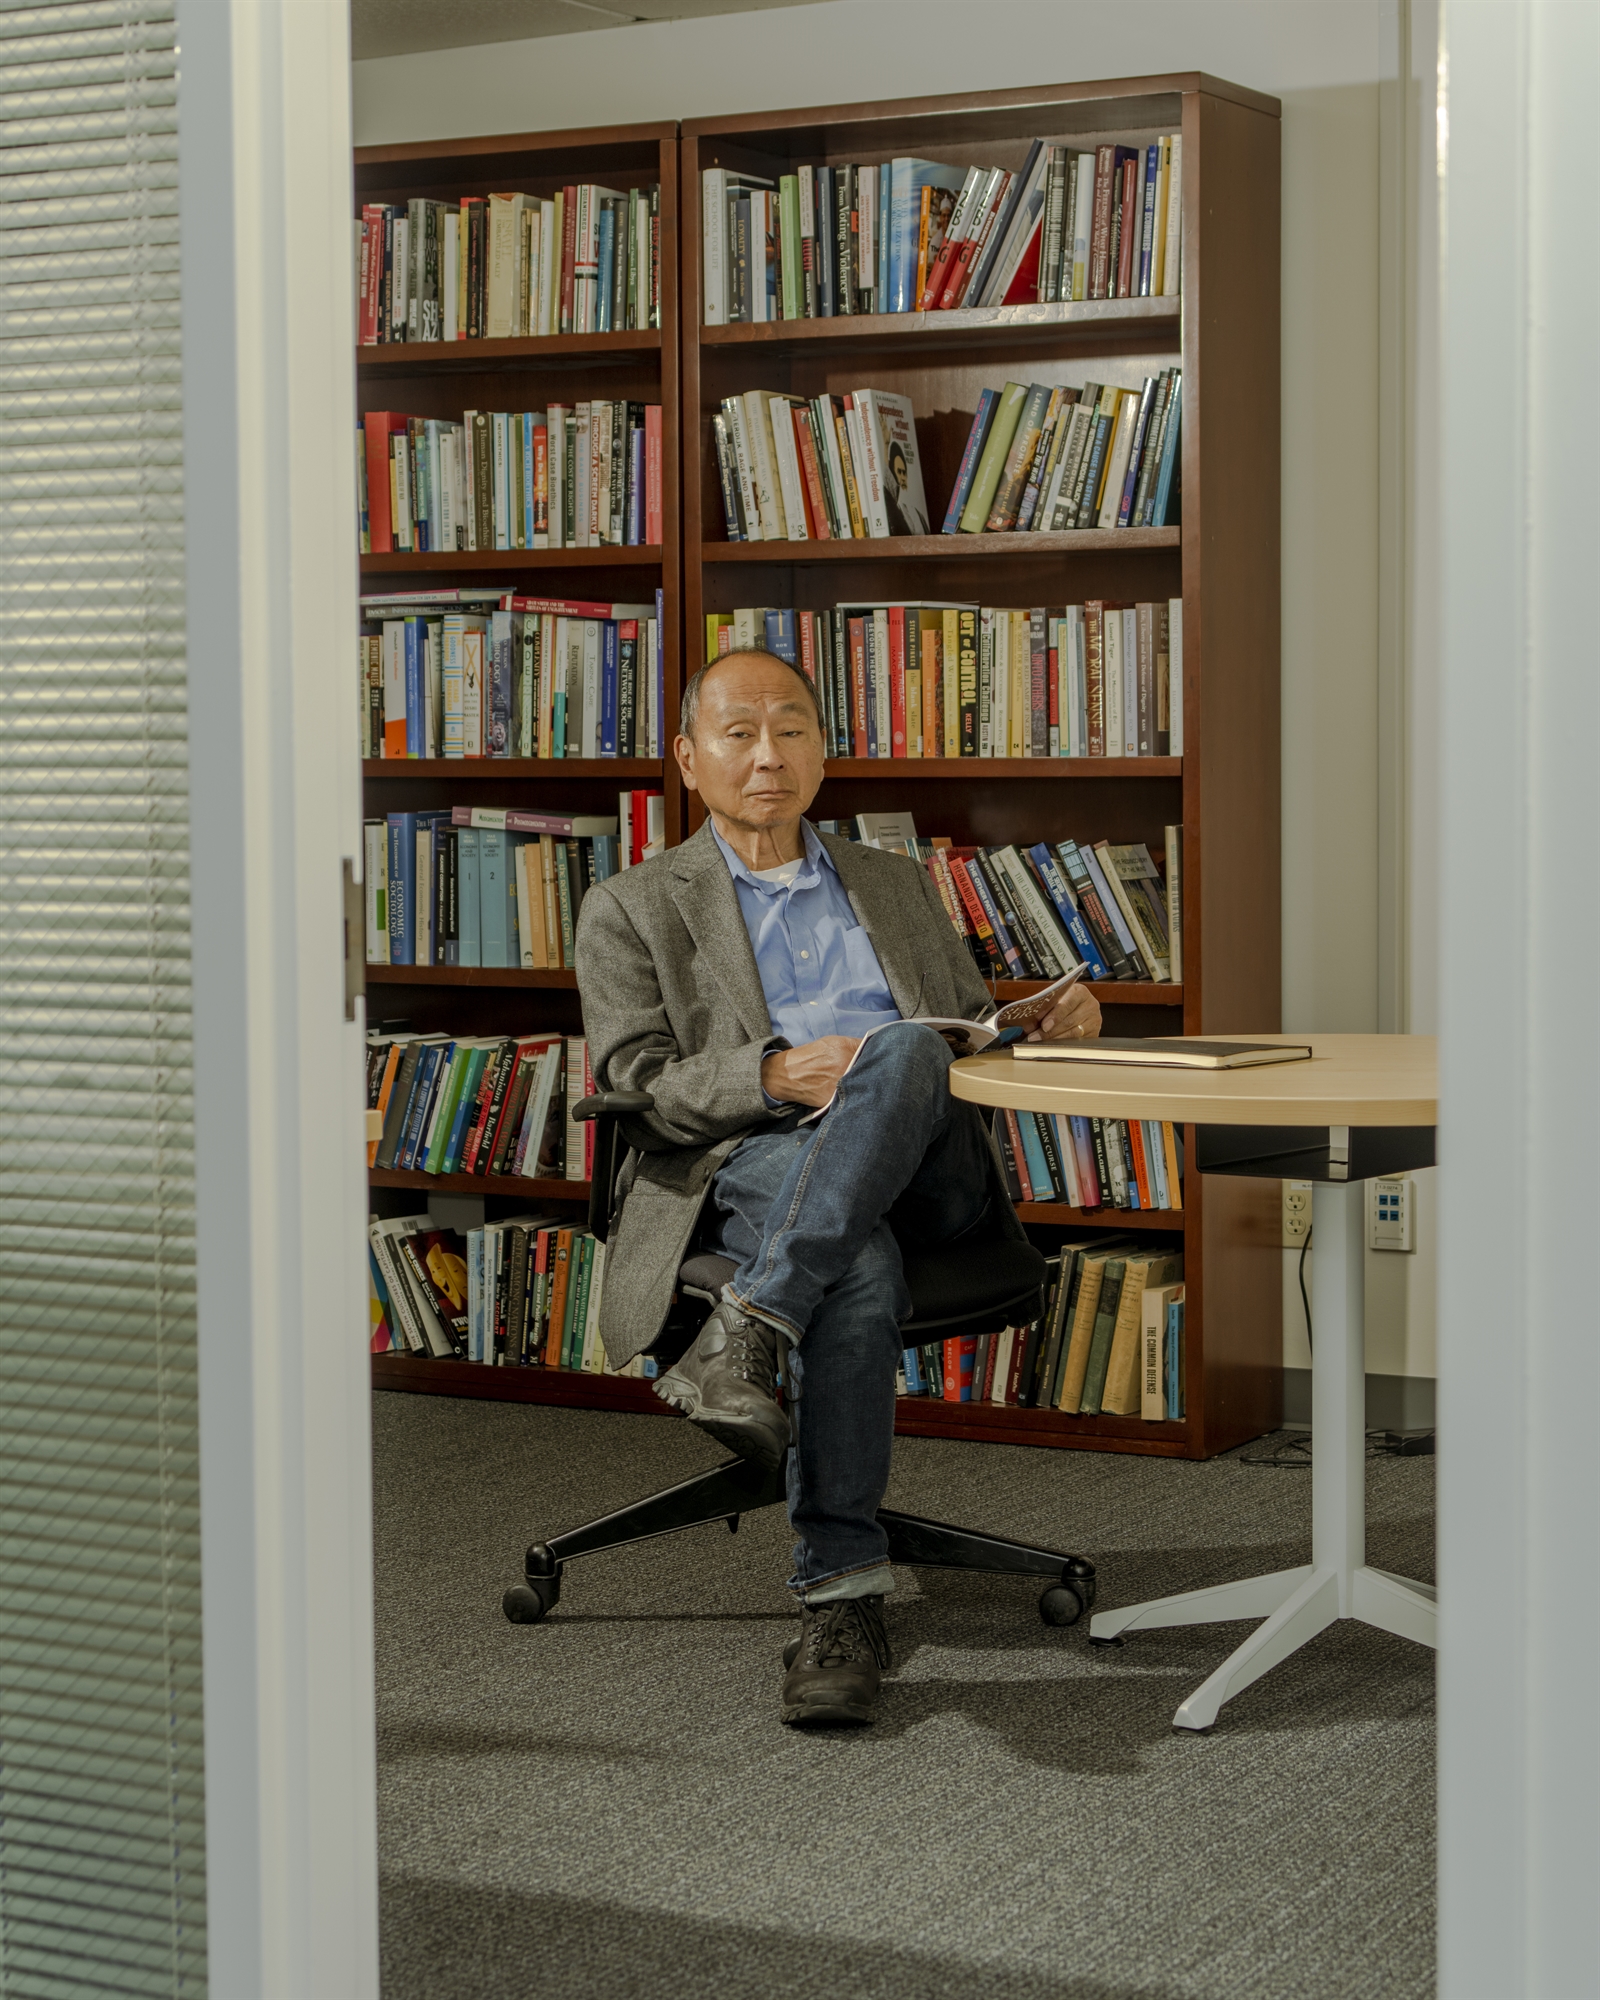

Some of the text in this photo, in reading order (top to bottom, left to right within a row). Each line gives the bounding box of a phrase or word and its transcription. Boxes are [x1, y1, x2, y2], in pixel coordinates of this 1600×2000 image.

[1143, 182, 1155, 251] ETHNIC ECONOMIES
[1169, 196, 1178, 233] Marriage
[803, 239, 812, 271] ILLICIT
[837, 186, 850, 294] From Voting to Violence
[1102, 392, 1111, 412] Glazer
[971, 414, 981, 434] PEOPLE
[1013, 392, 1042, 475] LAND OF PROMISE
[1097, 419, 1106, 439] FROM
[738, 453, 746, 473] RAGE
[860, 401, 880, 502] Independence without Freedom
[960, 457, 969, 474] TRUST
[1061, 415, 1083, 494] CHARLES MURRAY
[1066, 417, 1089, 497] LOSING GROUND
[1074, 427, 1095, 503] RETHINKING SOCIAL POLICY
[1091, 445, 1100, 468] CAUSE
[480, 461, 488, 490] Dignity
[568, 479, 574, 488] OF
[741, 476, 749, 492] AND
[802, 444, 812, 473] WILLIAM
[809, 481, 818, 506] DOBSON
[1089, 469, 1097, 478] TO
[948, 476, 963, 515] GOVERNMENT
[1082, 484, 1093, 507] STYLE
[960, 612, 974, 637] OUT
[571, 645, 579, 686] REPUTATION
[876, 631, 885, 673] Conjectures
[1086, 635, 1102, 679] MORAL
[371, 667, 379, 686] MALES
[961, 650, 976, 706] CONTROL
[981, 634, 990, 722] Collaboration Challenge
[1032, 654, 1043, 710] UNTO OTHERS
[620, 659, 629, 743] NETWORK SOCIETY
[627, 696, 632, 704] OF
[878, 681, 886, 736] Confrontations
[1088, 685, 1103, 728] SENSE
[932, 863, 943, 882] INDIA
[968, 863, 994, 917] THE OTHER PATH
[1014, 873, 1025, 885] THE
[953, 864, 987, 934] HERNANDO DE SOTO
[1019, 886, 1036, 905] LIMITS
[1035, 910, 1048, 930] SOCIAL
[1046, 930, 1067, 961] COHESION
[481, 1051, 513, 1149] Afghanistan Barfield
[495, 1077, 522, 1155] SUPPLYING WAR
[1037, 1113, 1057, 1171] BERIAN CURSE
[1165, 1121, 1173, 1141] God?
[510, 1231, 524, 1348] JUSTICE AMONG NATIONS
[904, 1349, 912, 1377] politics
[1146, 1326, 1157, 1395] THE COMMON DEFENSE
